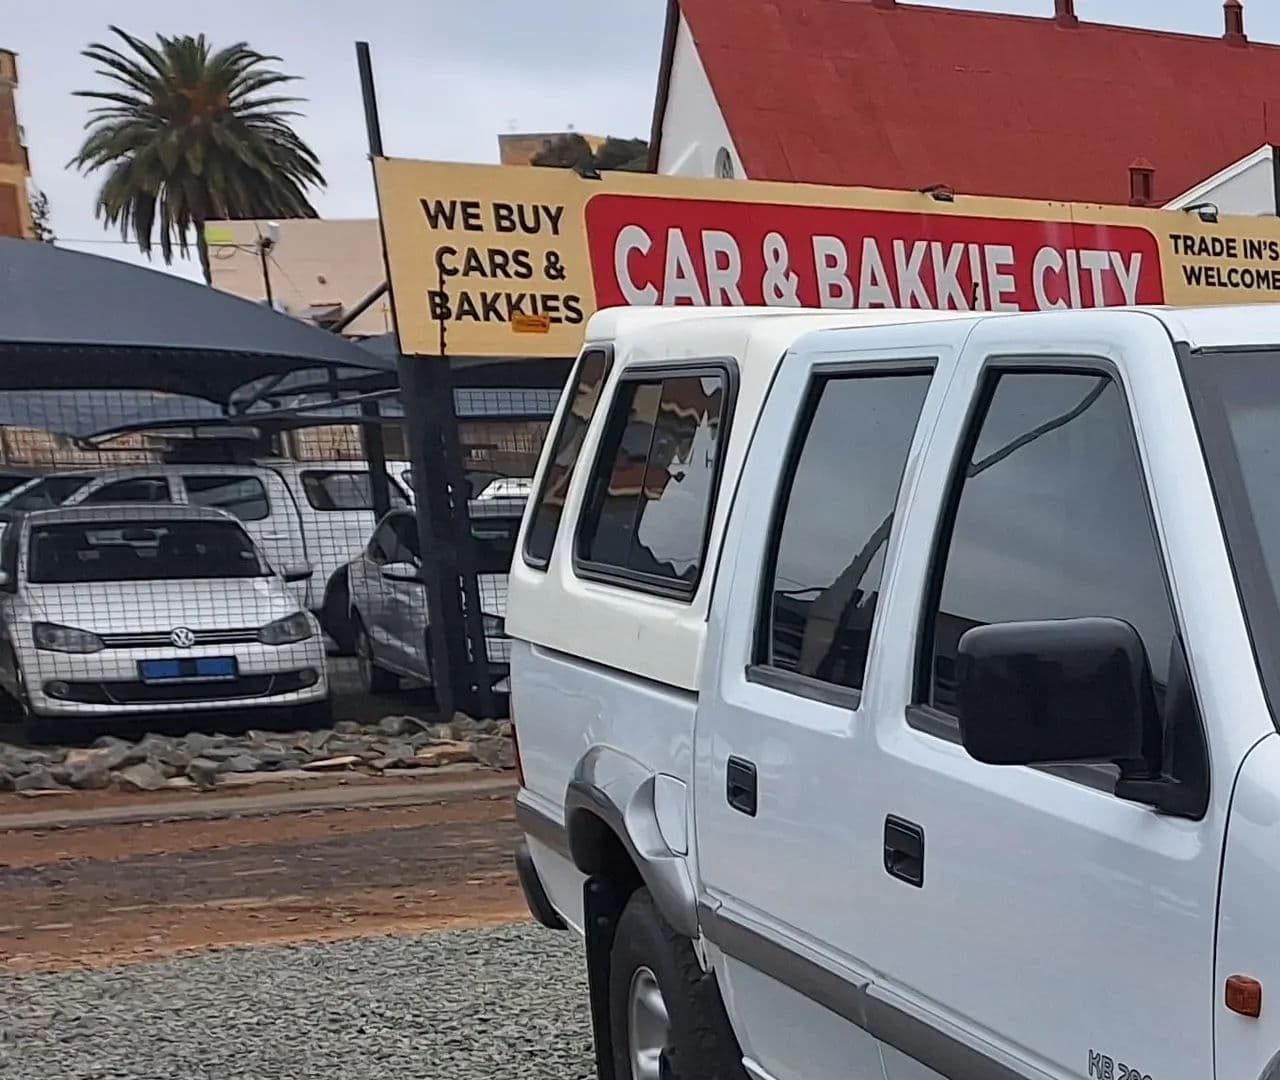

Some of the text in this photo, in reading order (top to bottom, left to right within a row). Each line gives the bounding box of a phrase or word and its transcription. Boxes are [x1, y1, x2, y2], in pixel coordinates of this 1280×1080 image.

[420, 198, 564, 235] WE BUY
[435, 246, 566, 281] CARS &
[1169, 233, 1280, 261] TRADE IN'S
[614, 225, 1143, 311] CAR & BAKKIE CITY
[427, 290, 584, 325] BAKKIES
